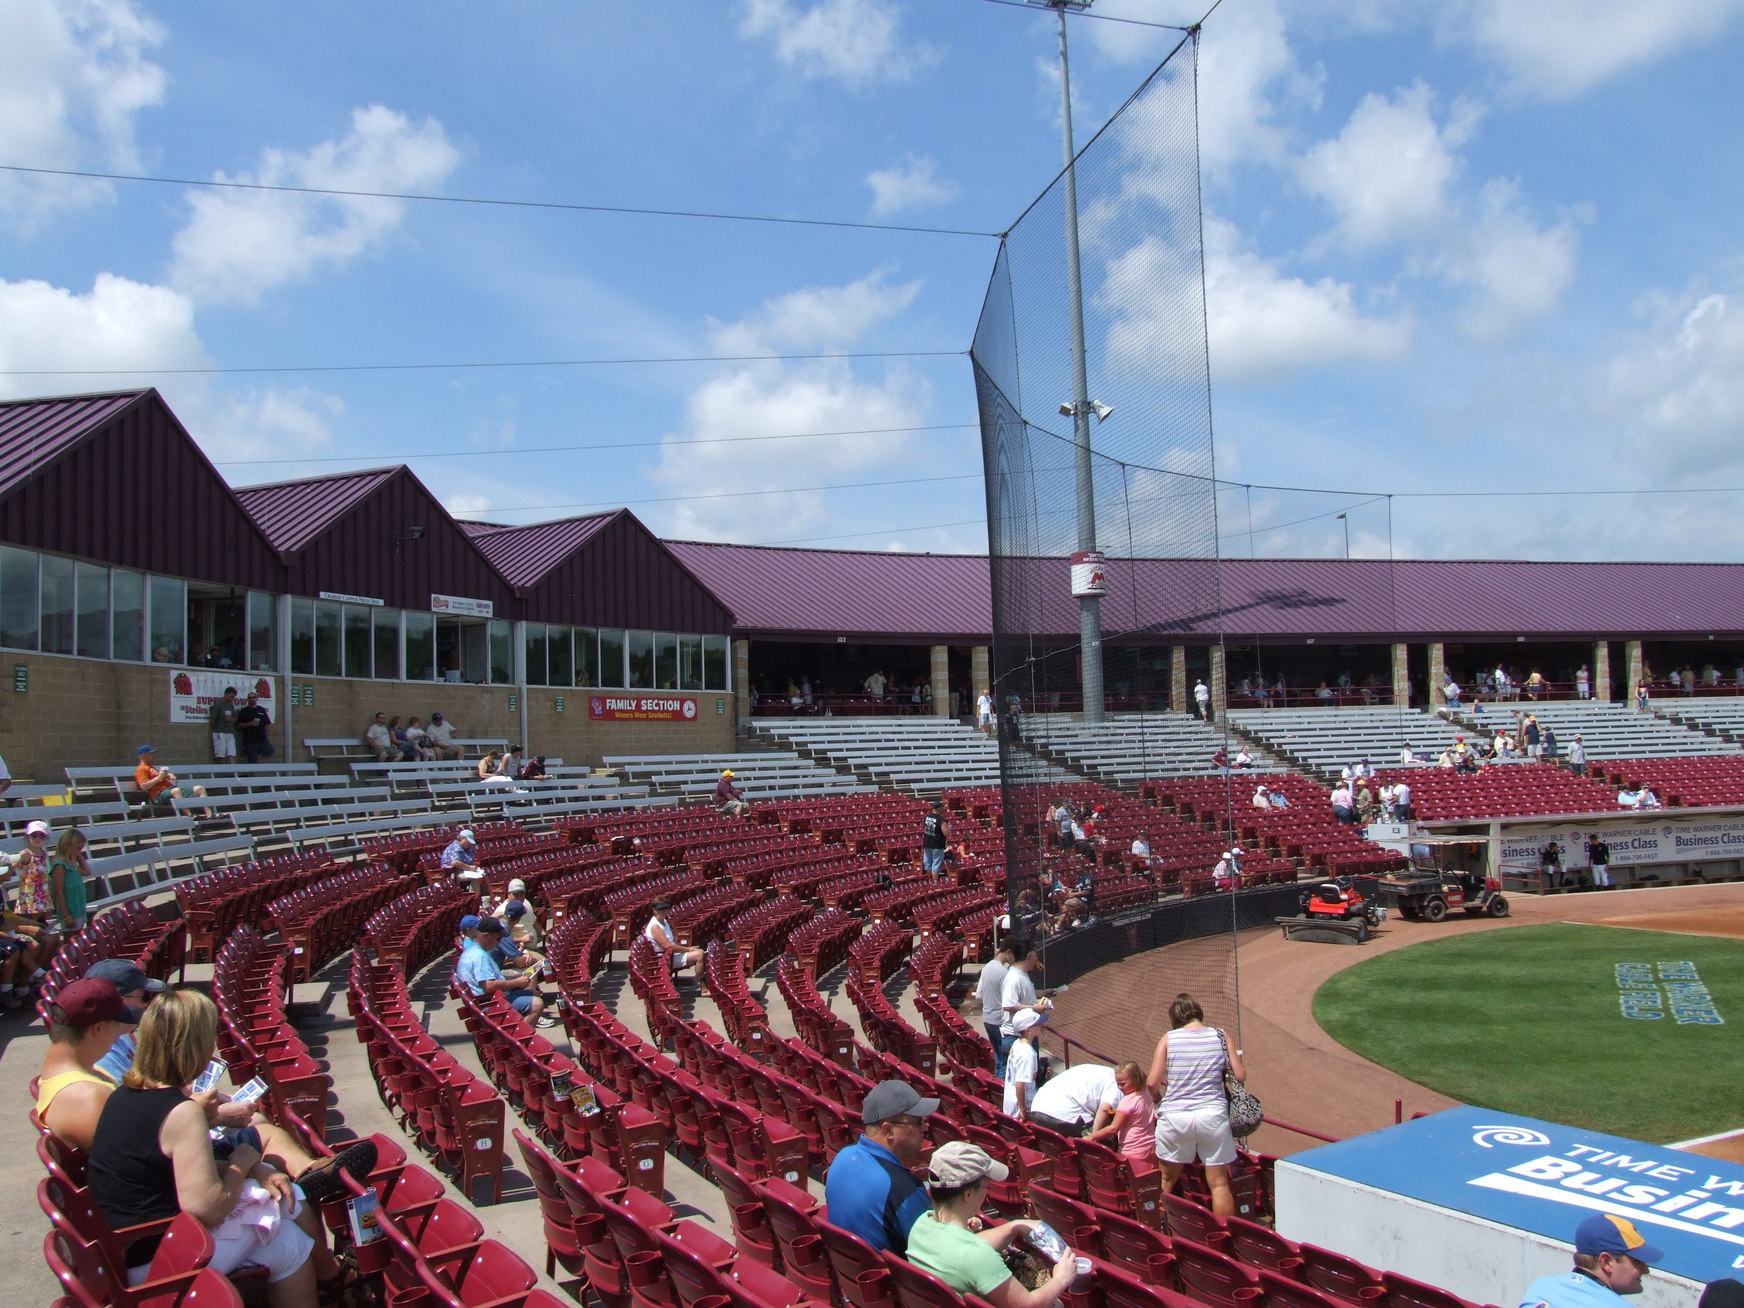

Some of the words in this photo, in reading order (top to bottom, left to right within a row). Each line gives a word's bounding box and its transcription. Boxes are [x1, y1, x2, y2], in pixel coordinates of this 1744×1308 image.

[606, 698, 637, 710] FAMILY
[641, 699, 681, 711] SECTION
[615, 711, 634, 719] Winners
[1602, 829, 1632, 838] WARNER
[1633, 828, 1657, 836] CABLE
[1675, 826, 1692, 834] TIME
[1692, 825, 1722, 833] WARNER
[1631, 837, 1658, 850] Class
[1675, 834, 1720, 847] Business
[1564, 1143, 1696, 1182] TIME
[1506, 1154, 1744, 1230] Busin
